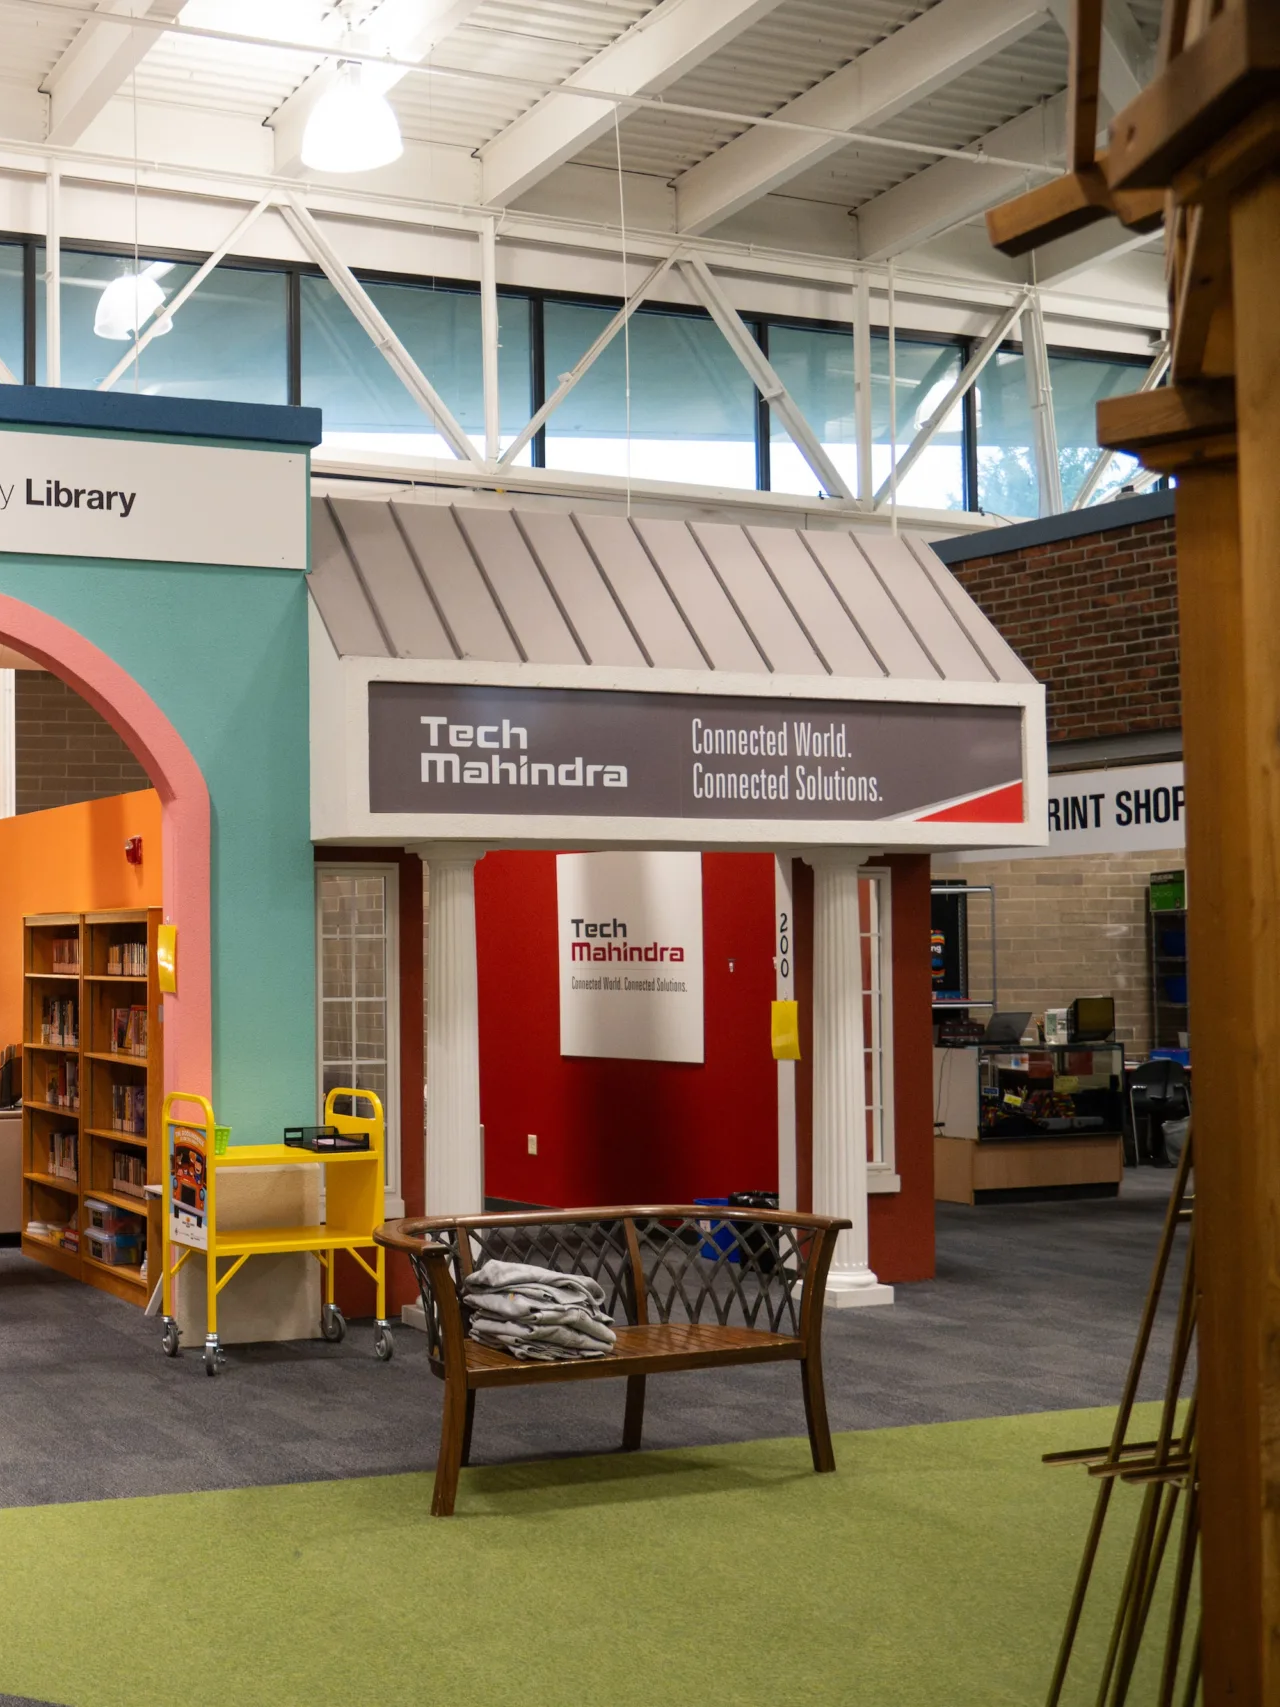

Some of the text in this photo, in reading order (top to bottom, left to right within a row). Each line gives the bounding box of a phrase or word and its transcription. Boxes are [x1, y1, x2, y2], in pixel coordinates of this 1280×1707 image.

[25, 477, 137, 518] Library
[420, 715, 528, 750] Tech
[691, 717, 853, 759] Connected World.
[420, 752, 629, 788] Mahindra
[692, 762, 884, 802] Connected Solutions.
[1048, 785, 1186, 832] RINT SHOP
[570, 918, 628, 938] Tech
[780, 912, 790, 978] 200
[571, 941, 685, 962] Mahindra
[571, 976, 688, 993] Connected World. Connected Solutions.
